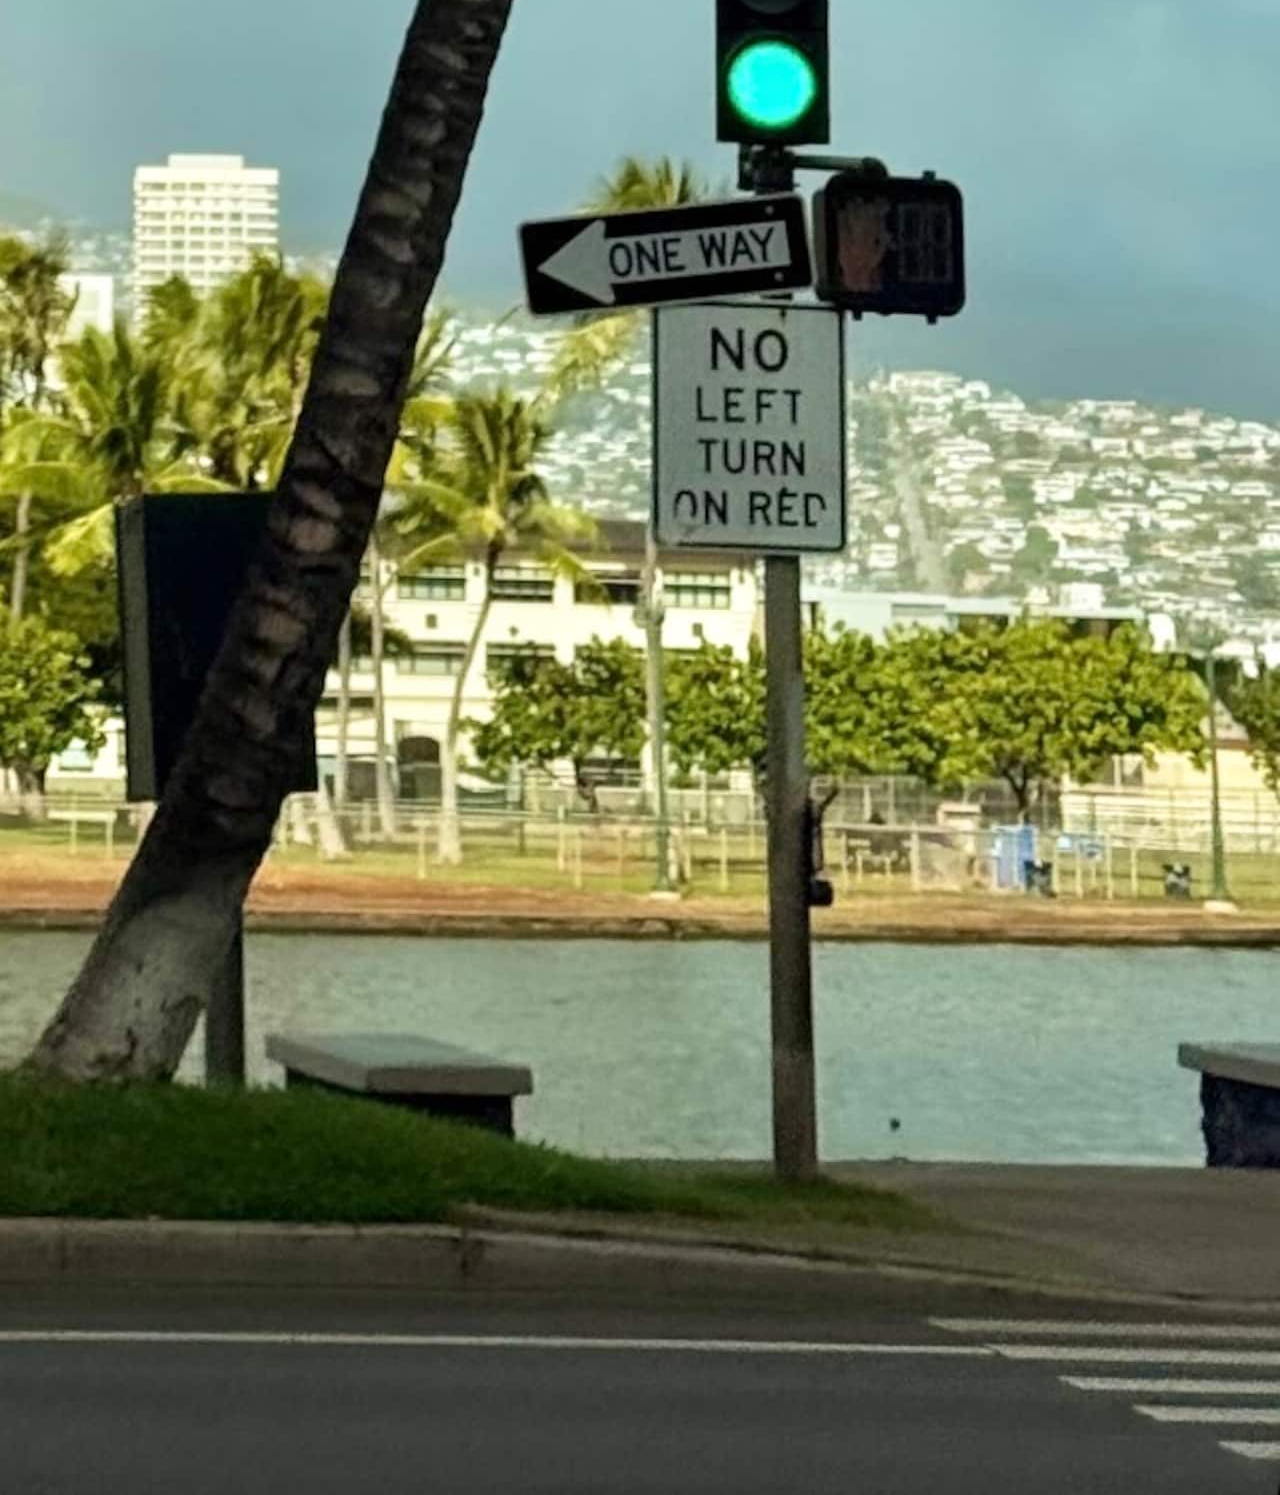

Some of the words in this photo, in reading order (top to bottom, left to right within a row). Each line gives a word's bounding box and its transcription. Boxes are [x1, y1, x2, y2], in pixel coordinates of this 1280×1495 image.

[609, 236, 686, 278] ONE
[699, 225, 775, 268] WAY
[710, 327, 789, 373] NO
[696, 386, 802, 425] LEFT
[698, 438, 805, 476] TURN
[673, 490, 728, 527] ON
[749, 489, 826, 528] RED
